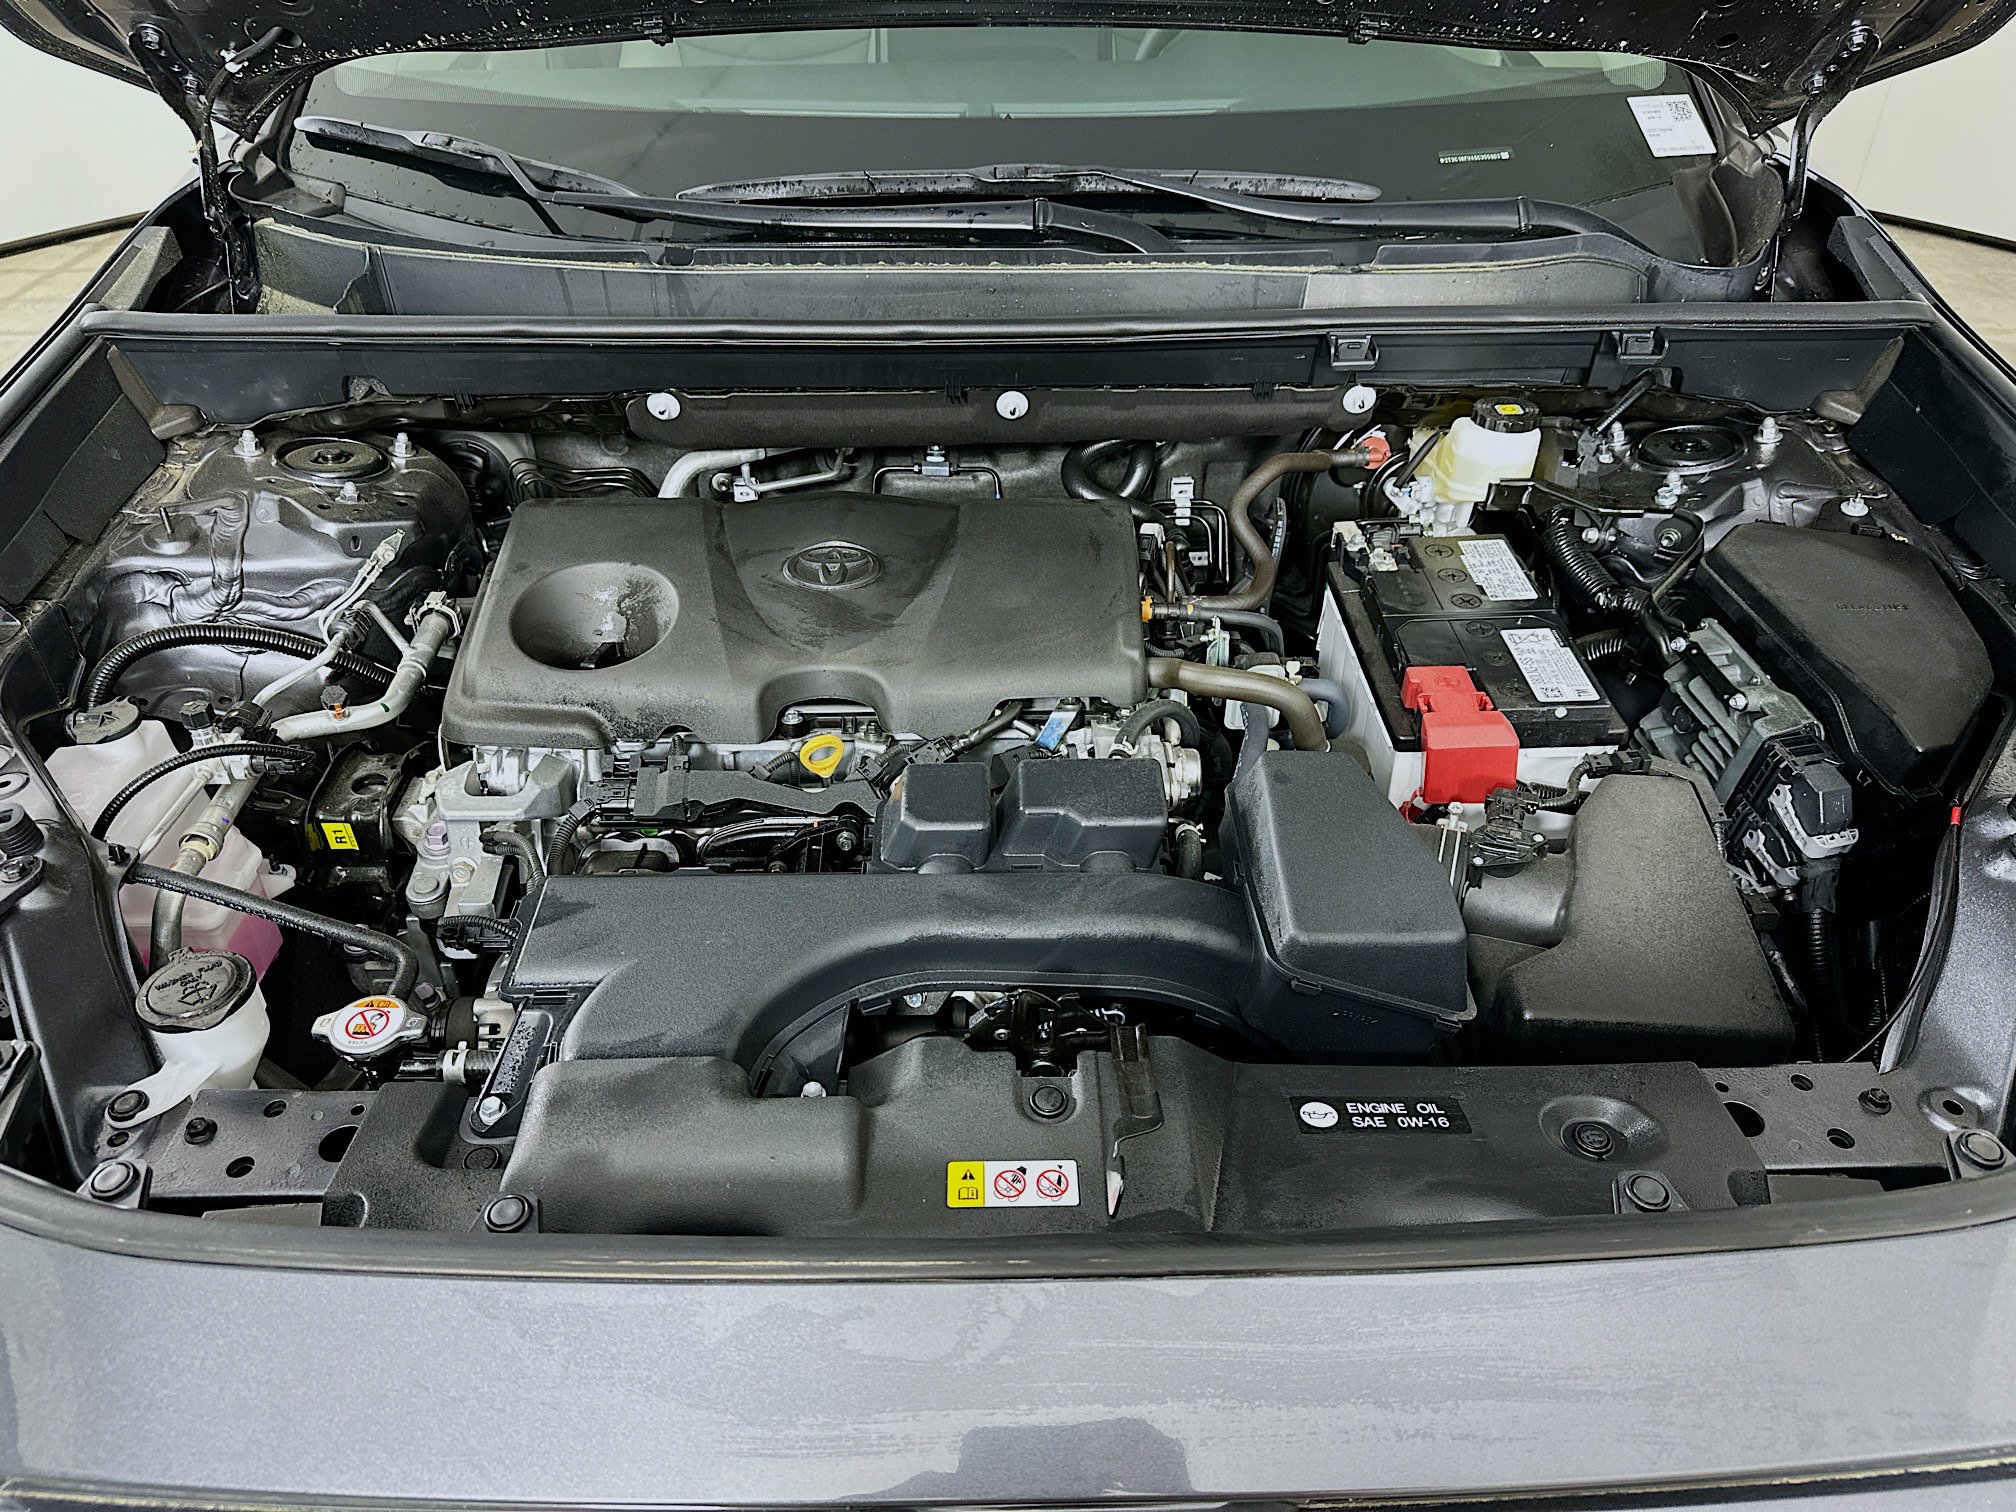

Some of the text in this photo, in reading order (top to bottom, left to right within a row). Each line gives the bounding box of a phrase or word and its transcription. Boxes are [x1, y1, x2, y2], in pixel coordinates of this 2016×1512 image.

[332, 829, 348, 844] R1
[1345, 1102, 1445, 1114] ENGINE OIL
[1352, 1116, 1450, 1128] SAE 0W-16
